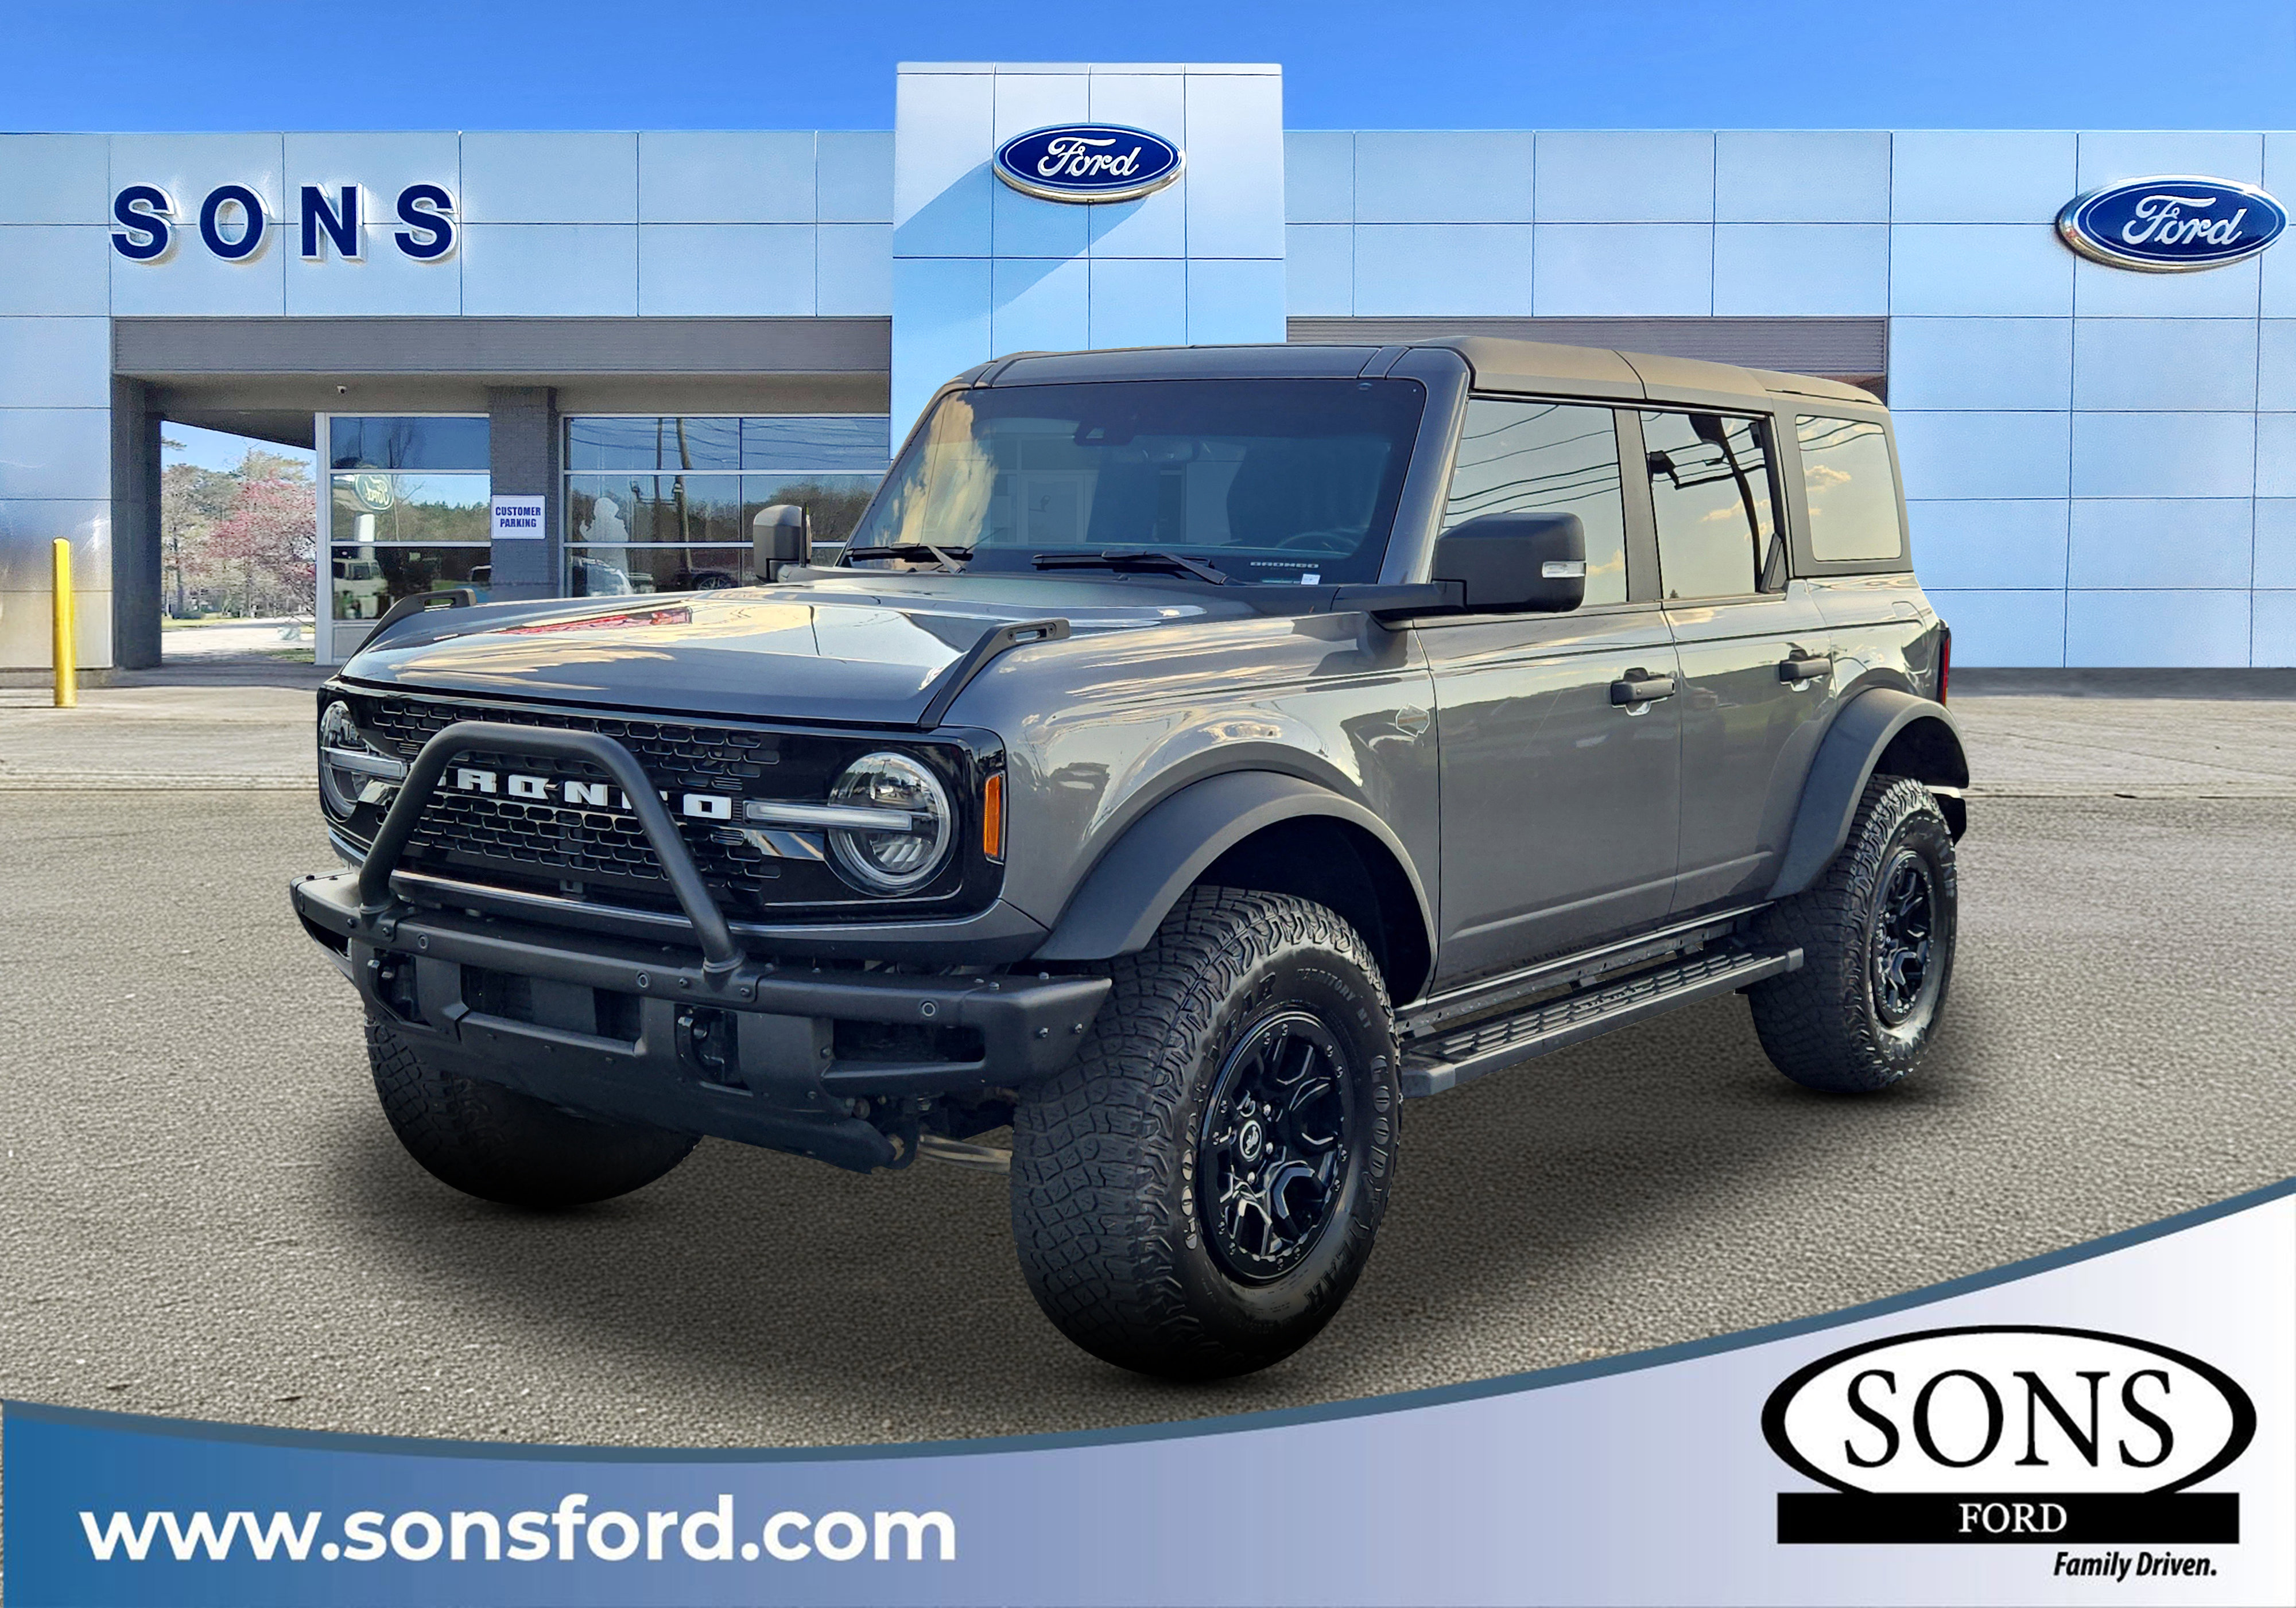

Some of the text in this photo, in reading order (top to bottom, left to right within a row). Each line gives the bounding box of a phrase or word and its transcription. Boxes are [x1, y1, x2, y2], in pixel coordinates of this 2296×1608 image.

[1037, 137, 1142, 177] Ford
[111, 182, 458, 261] SONS
[2122, 195, 2248, 245] Ford
[495, 506, 541, 516] CUSTOMER
[500, 518, 537, 527] PARKING
[409, 761, 732, 820] RONO
